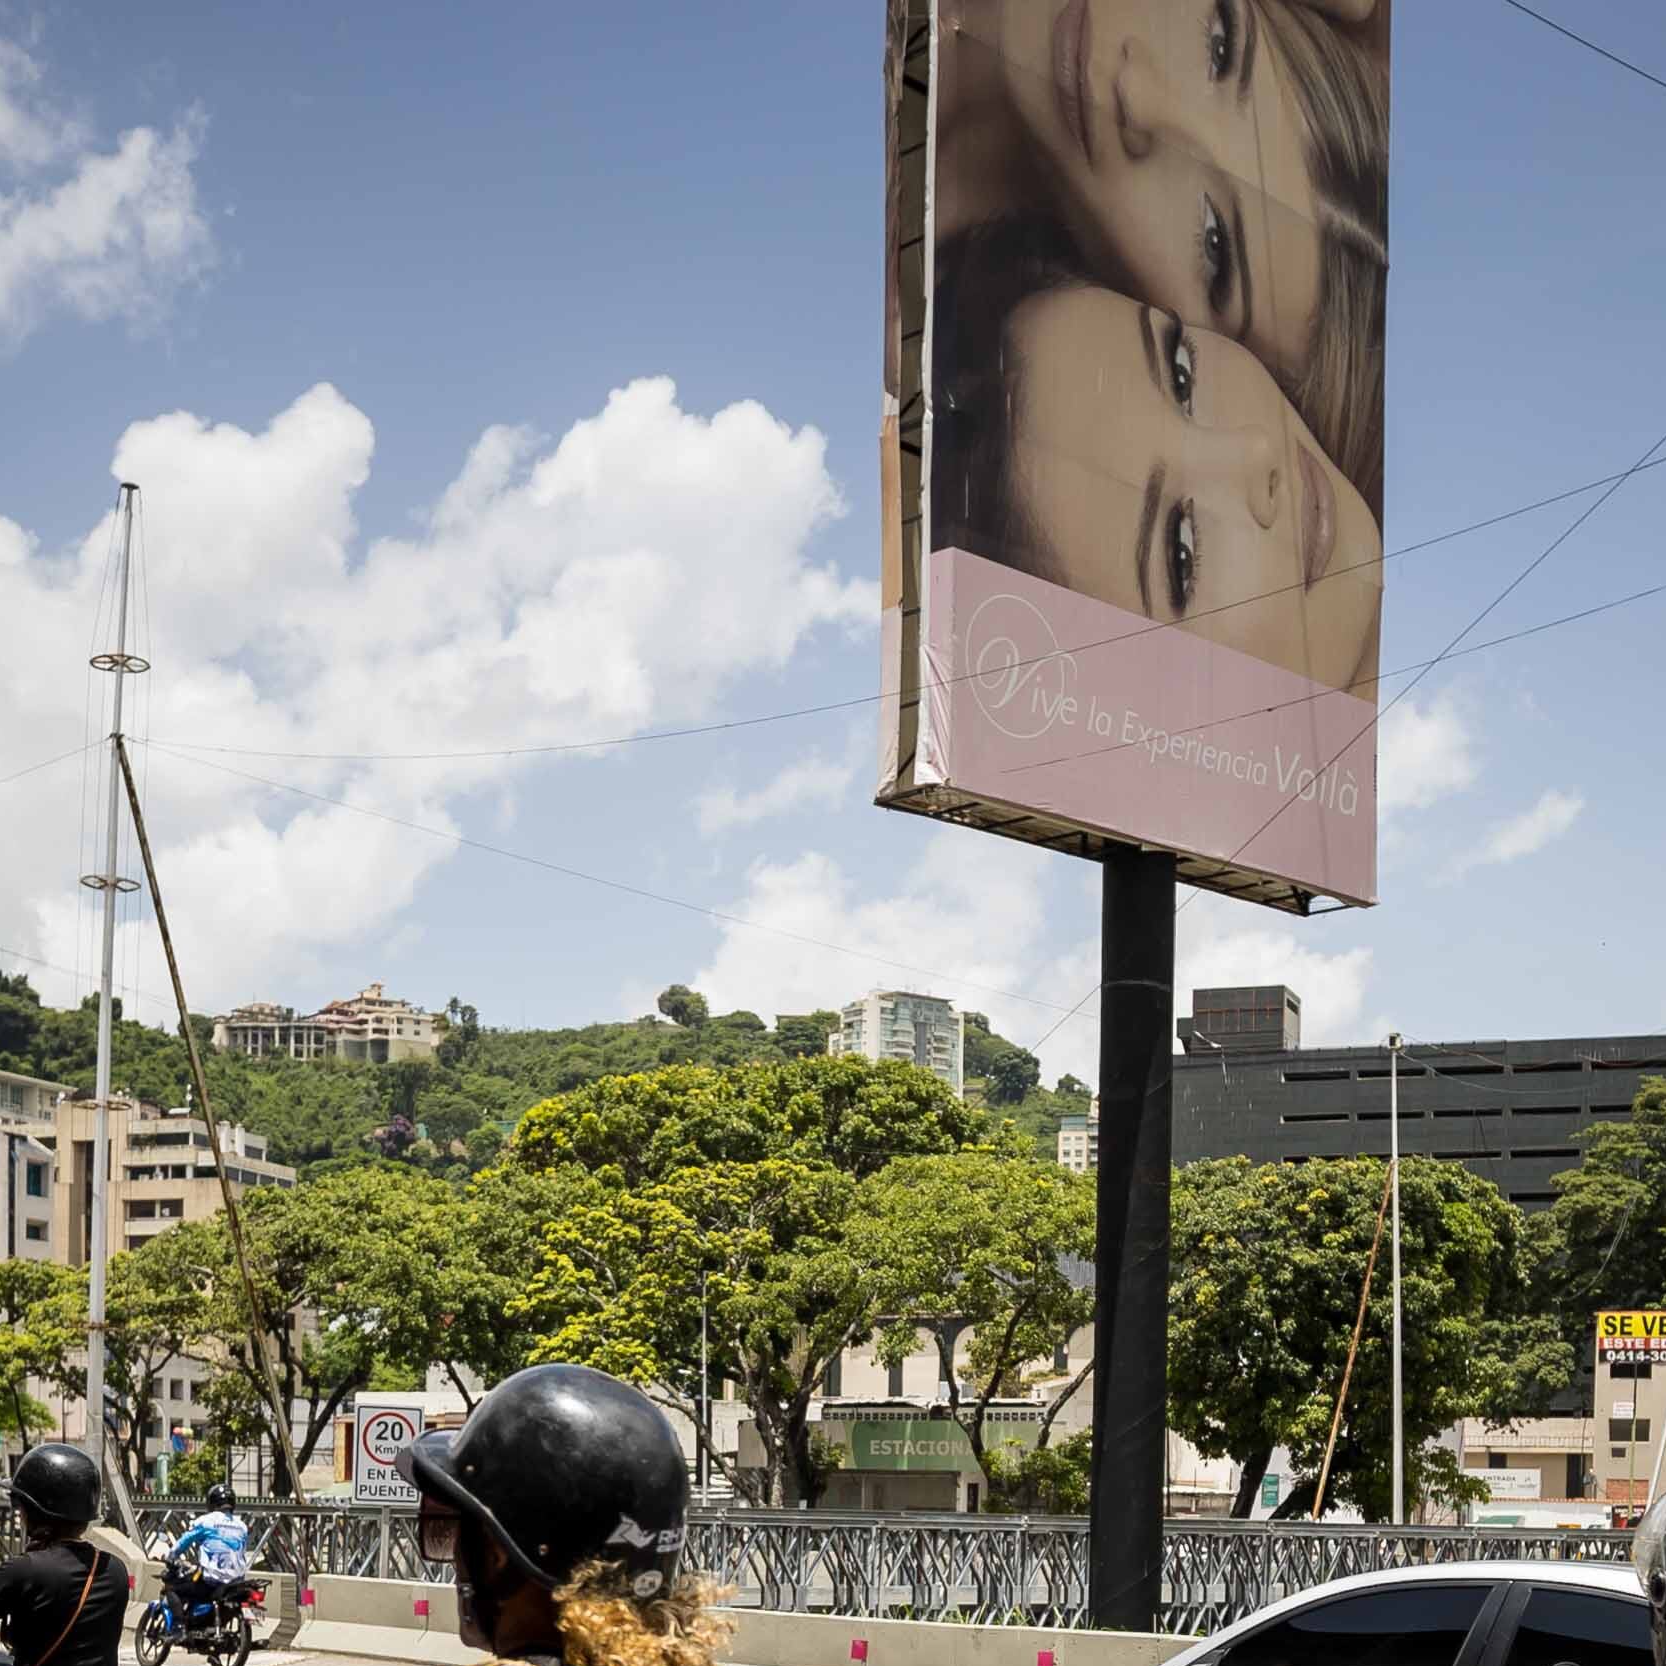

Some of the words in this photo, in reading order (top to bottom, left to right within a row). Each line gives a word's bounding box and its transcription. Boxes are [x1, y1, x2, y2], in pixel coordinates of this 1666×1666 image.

[977, 637, 1078, 725] Vive
[1087, 696, 1111, 738] la
[1122, 712, 1268, 786] Experiencia
[1274, 745, 1360, 817] Voilà
[1604, 1315, 1633, 1336] SE
[1603, 1338, 1646, 1350] ESTE
[376, 1421, 404, 1441] 20
[367, 1468, 386, 1480] EN
[359, 1484, 416, 1499] PUENTE
